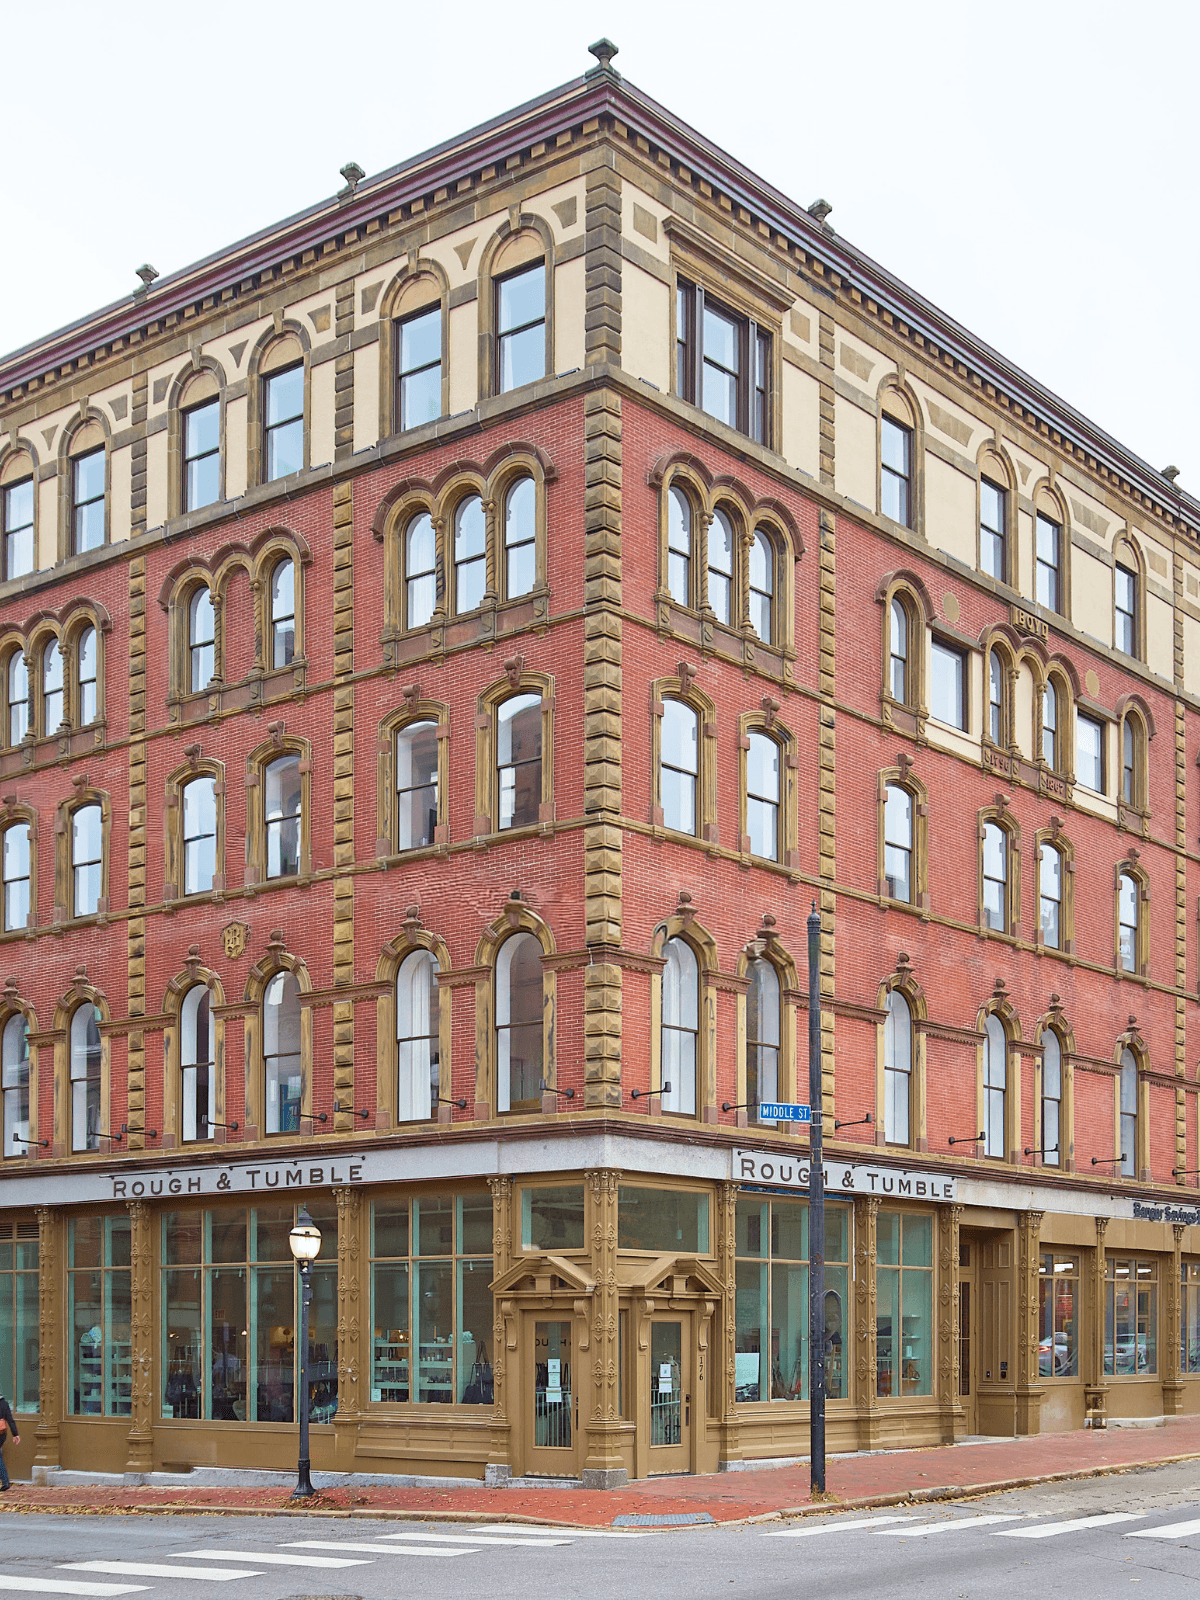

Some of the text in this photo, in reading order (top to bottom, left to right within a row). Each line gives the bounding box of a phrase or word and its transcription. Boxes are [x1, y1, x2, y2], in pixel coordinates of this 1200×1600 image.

[1017, 610, 1048, 638] BOYD
[1046, 778, 1063, 795] 1867
[763, 1106, 807, 1119] MIDDLE ST
[113, 1165, 363, 1198] ROUGH & TUMBLE
[842, 1170, 854, 1188] &
[867, 1173, 953, 1198] TUMBLE
